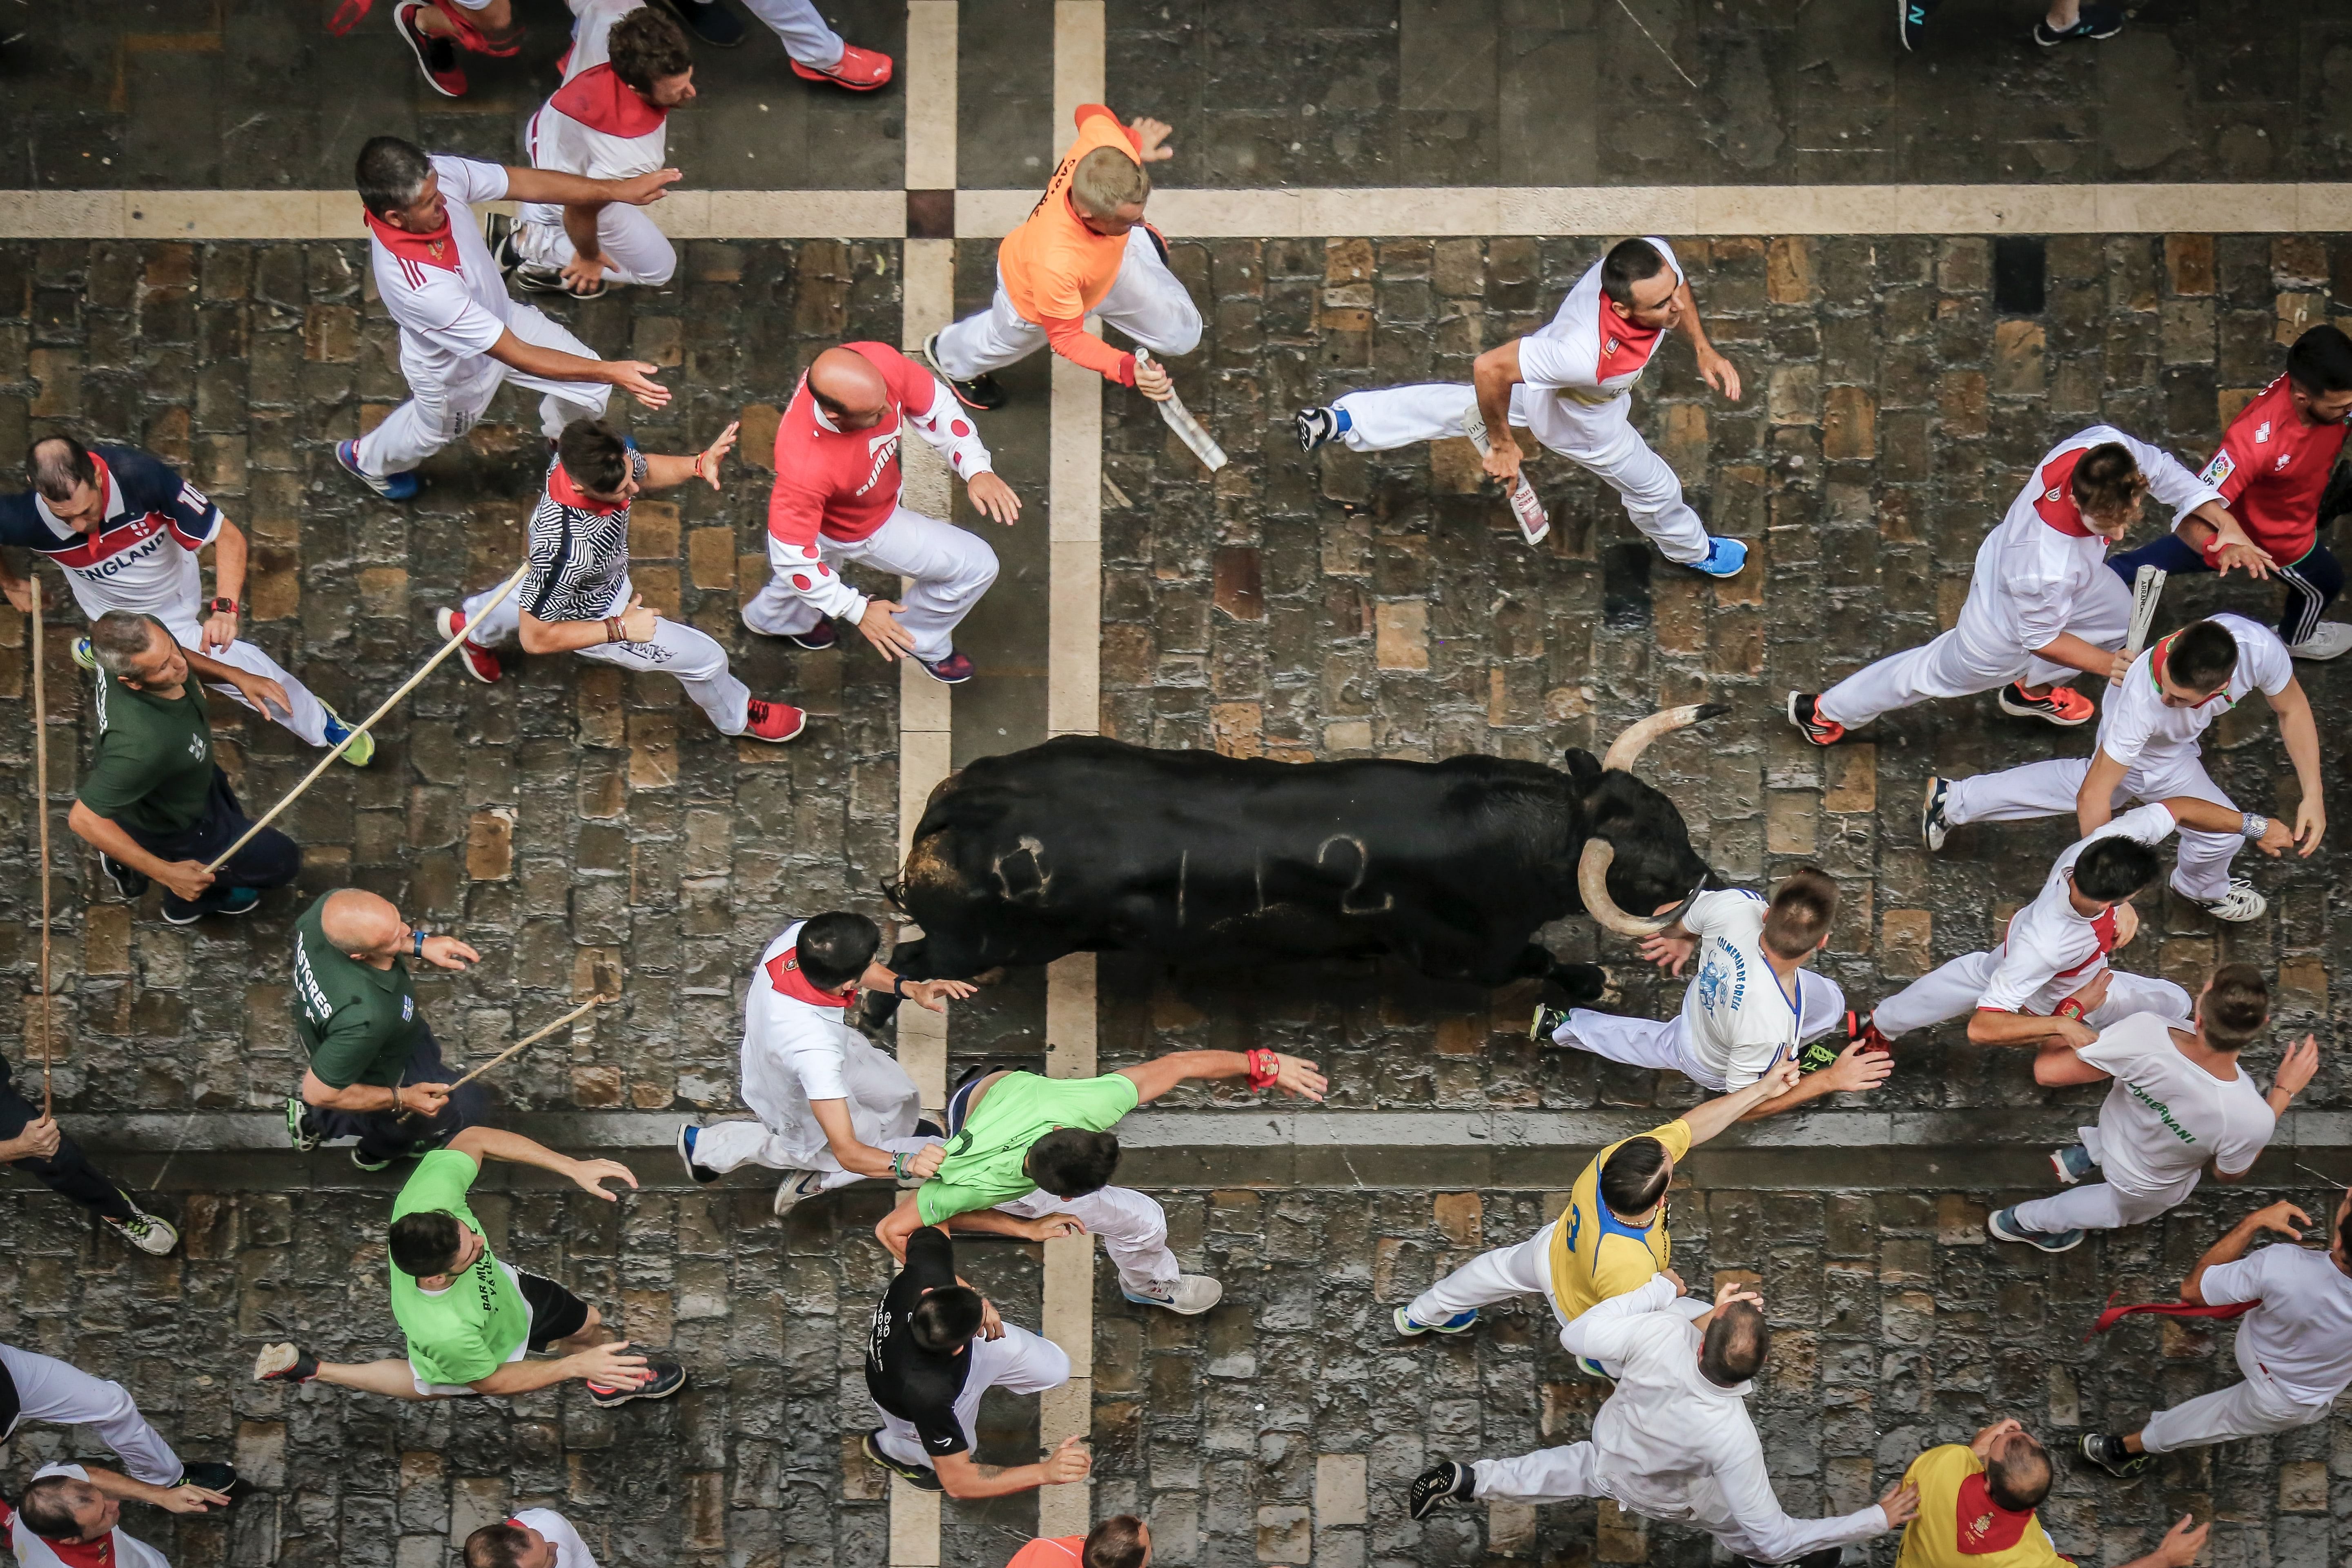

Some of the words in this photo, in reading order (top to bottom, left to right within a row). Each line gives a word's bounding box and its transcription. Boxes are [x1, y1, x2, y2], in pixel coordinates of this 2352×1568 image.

[2203, 474, 2215, 486] LFP
[177, 481, 208, 516] 10
[73, 532, 165, 581] ENGLAND
[1717, 935, 1746, 971] COLMENAR
[1736, 970, 1746, 982] DE
[1731, 984, 1745, 1011] OREJA
[479, 1285, 491, 1311] BAR
